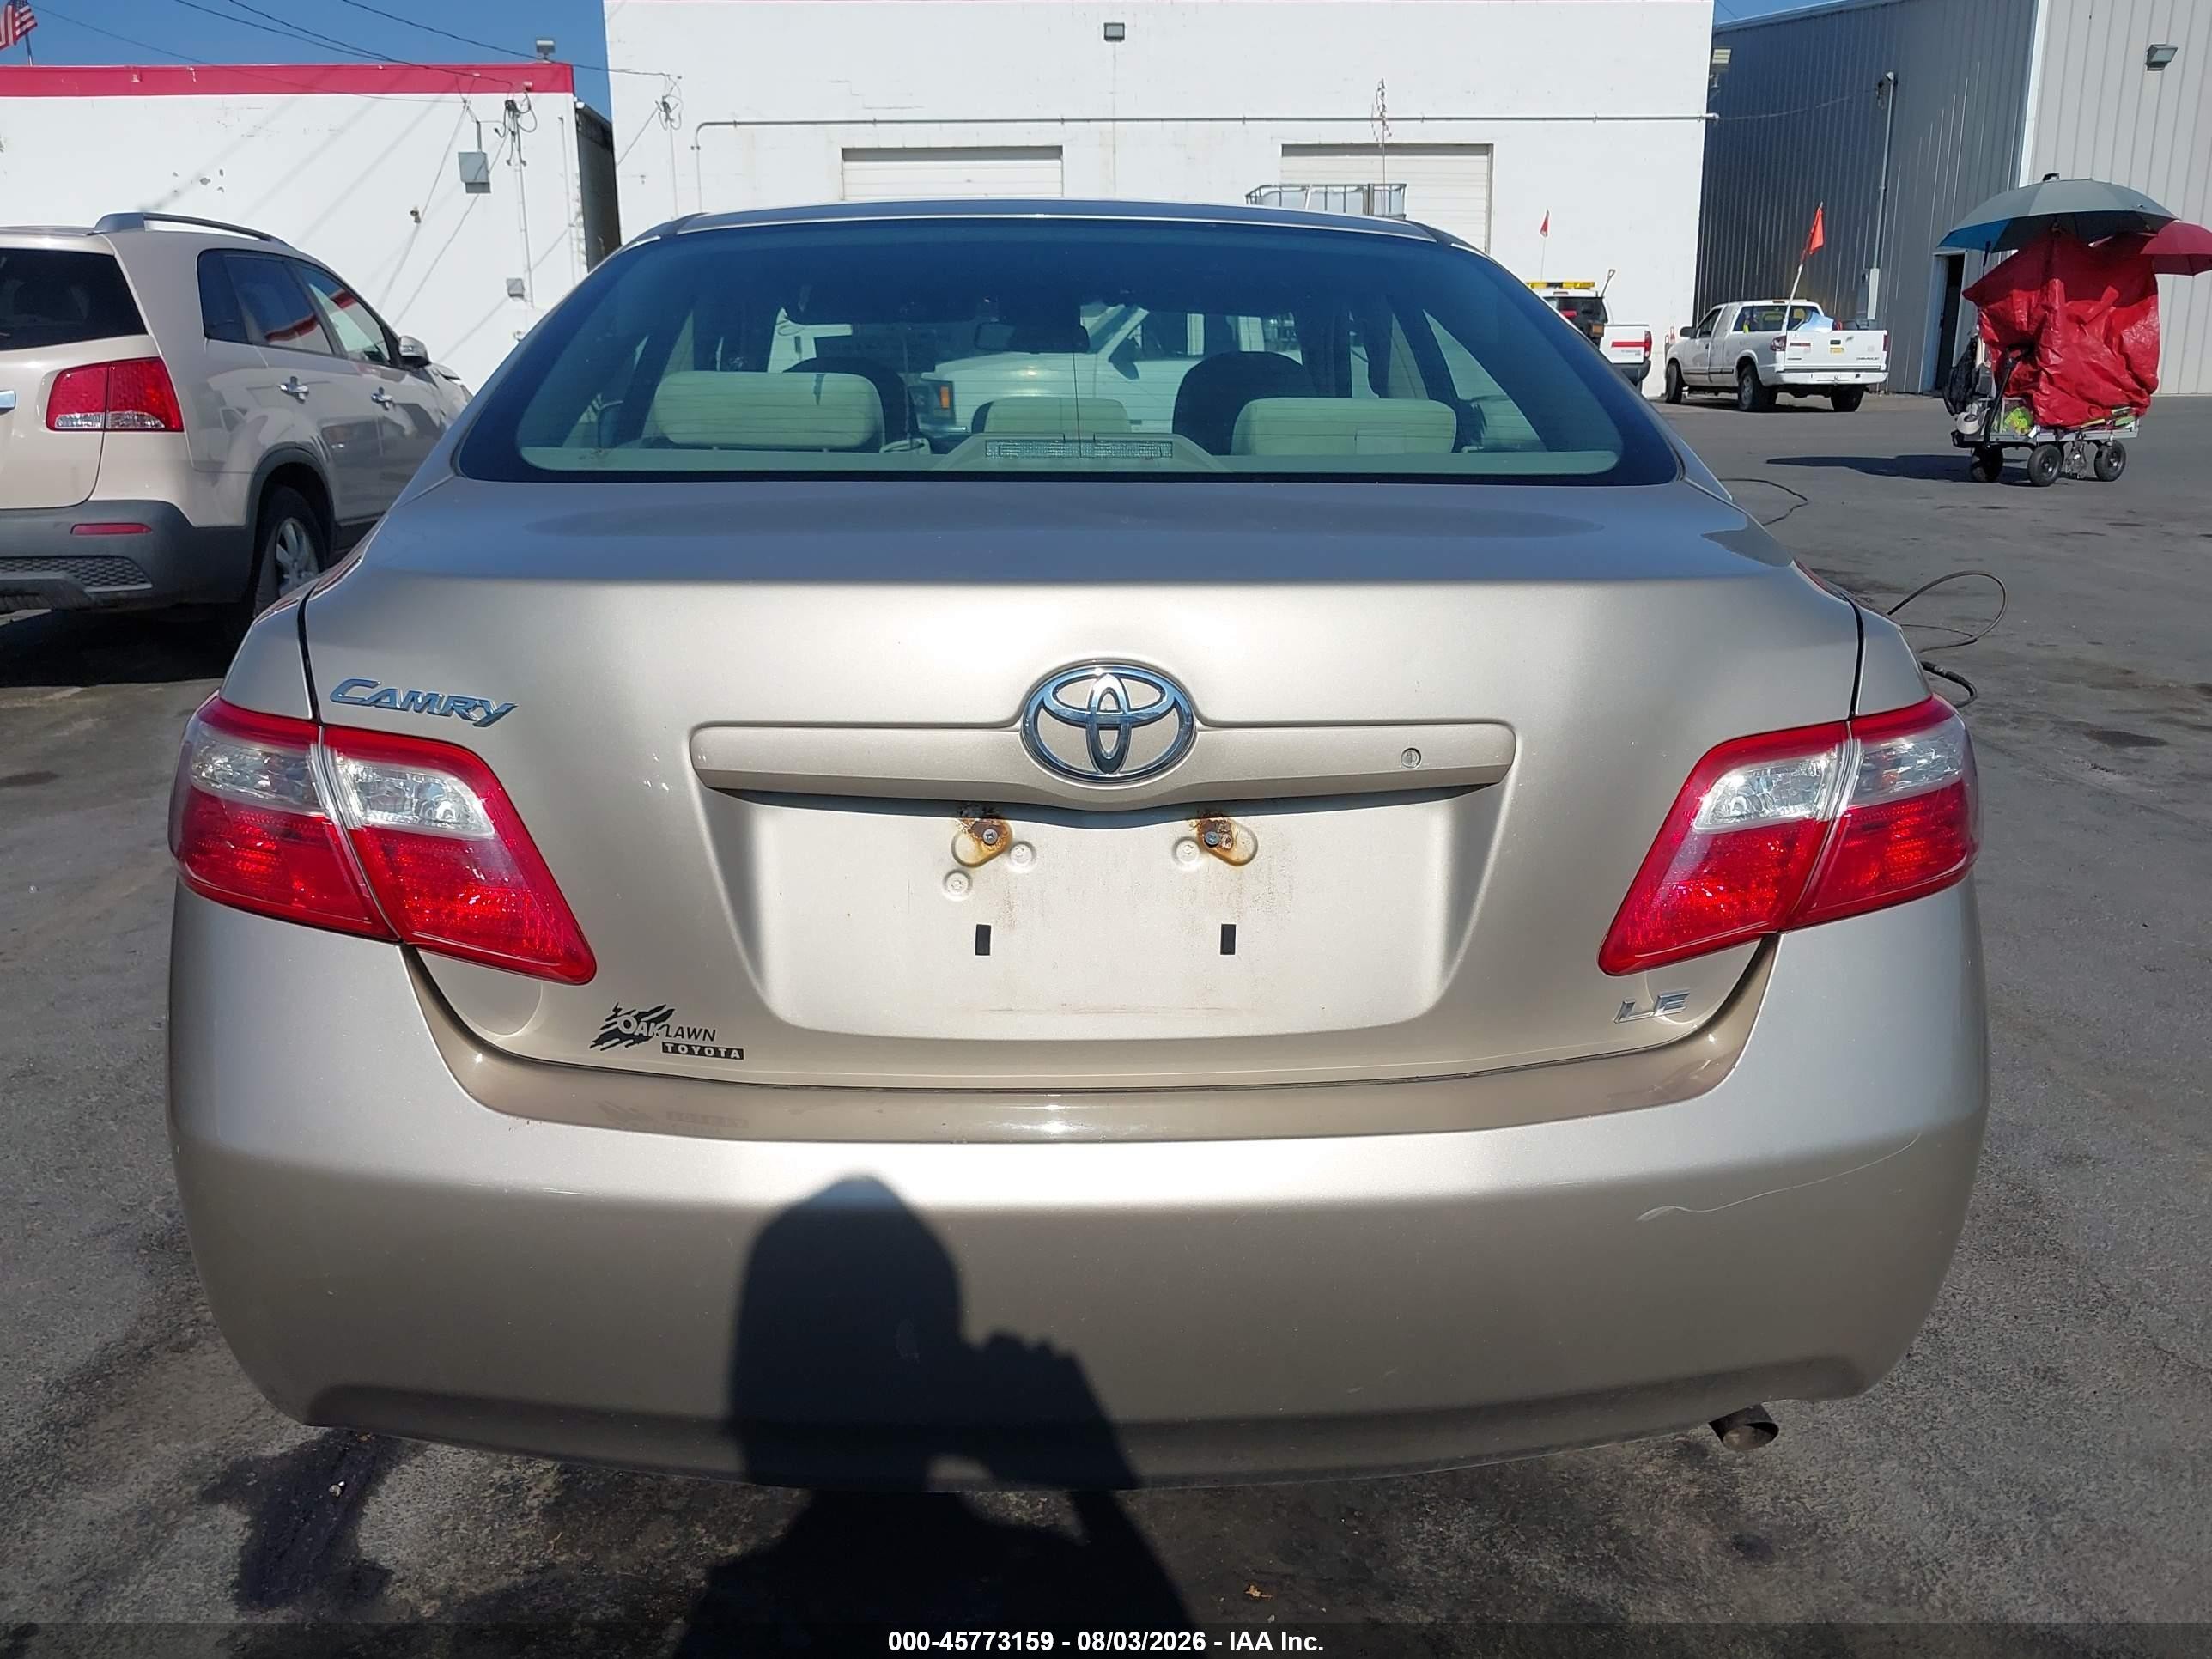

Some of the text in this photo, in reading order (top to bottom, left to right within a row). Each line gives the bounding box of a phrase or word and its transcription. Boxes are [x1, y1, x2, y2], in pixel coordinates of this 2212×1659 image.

[330, 678, 518, 727] CAMRY
[1613, 989, 1690, 1024] LE
[664, 1042, 741, 1060] TOYOTA
